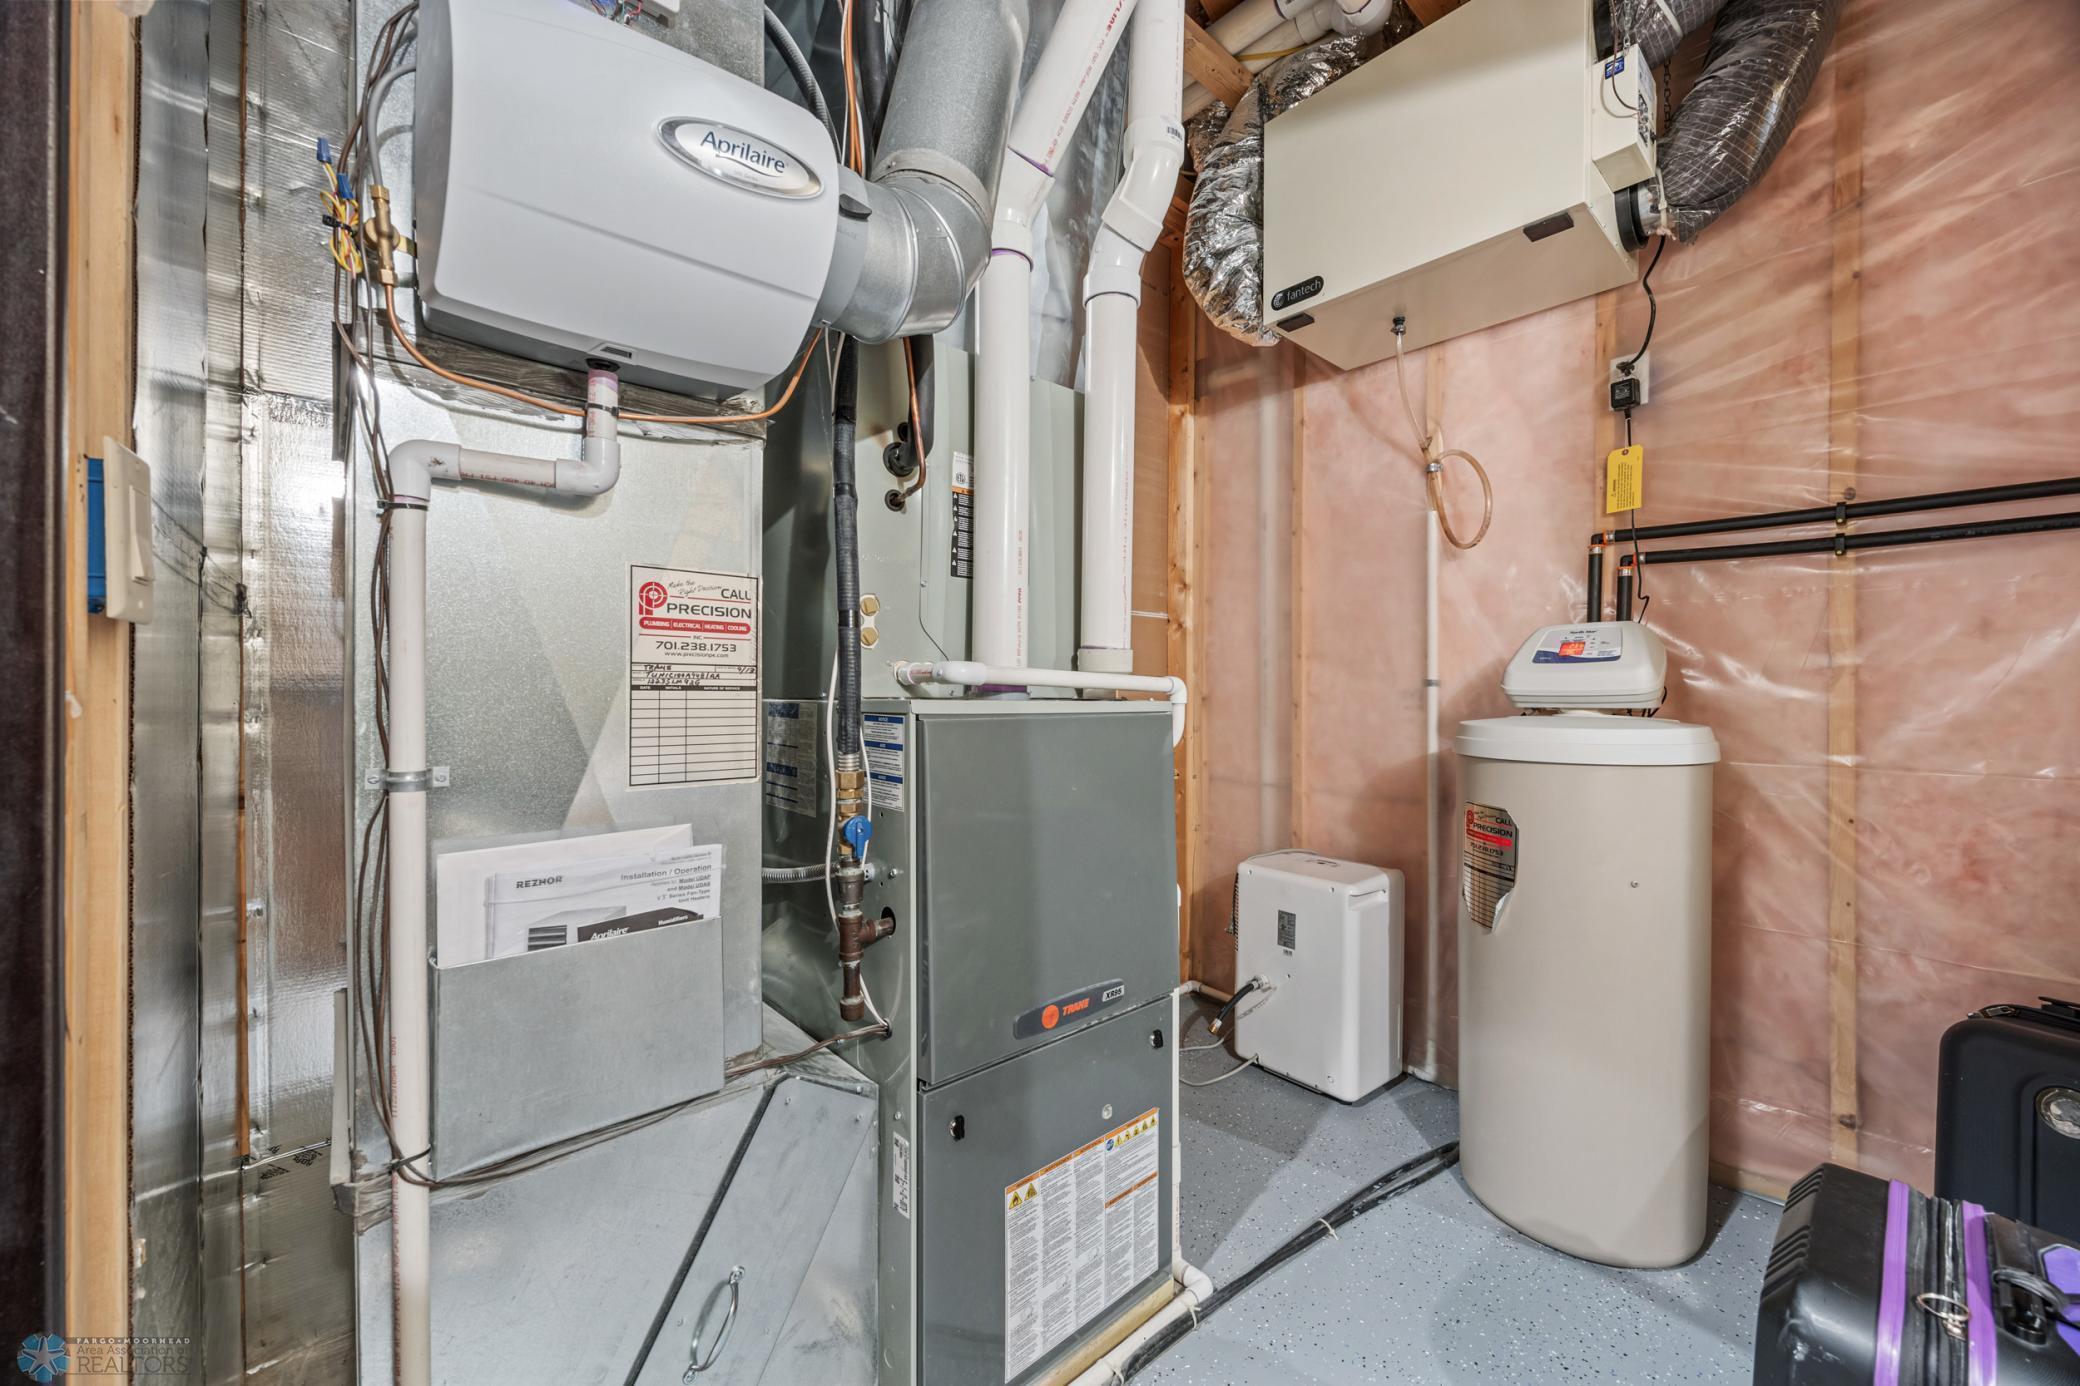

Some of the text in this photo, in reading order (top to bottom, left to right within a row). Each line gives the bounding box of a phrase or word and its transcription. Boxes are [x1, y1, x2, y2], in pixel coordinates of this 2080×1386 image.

[700, 130, 786, 174] Aprilaire
[1286, 279, 1321, 301] fantech
[721, 588, 752, 601] CALL
[666, 602, 752, 619] PRECISION
[643, 619, 670, 627] PLUMBING
[673, 622, 702, 630] ELECTRICAL
[655, 640, 737, 653] 701.238.1753
[1495, 816, 1513, 827] CALL
[1472, 822, 1513, 837] PRECISION
[620, 869, 667, 881] Installation
[673, 864, 712, 876] Operation
[515, 875, 563, 889] REZNOR
[1104, 987, 1122, 1000] XR95
[1062, 998, 1090, 1017] TRANE
